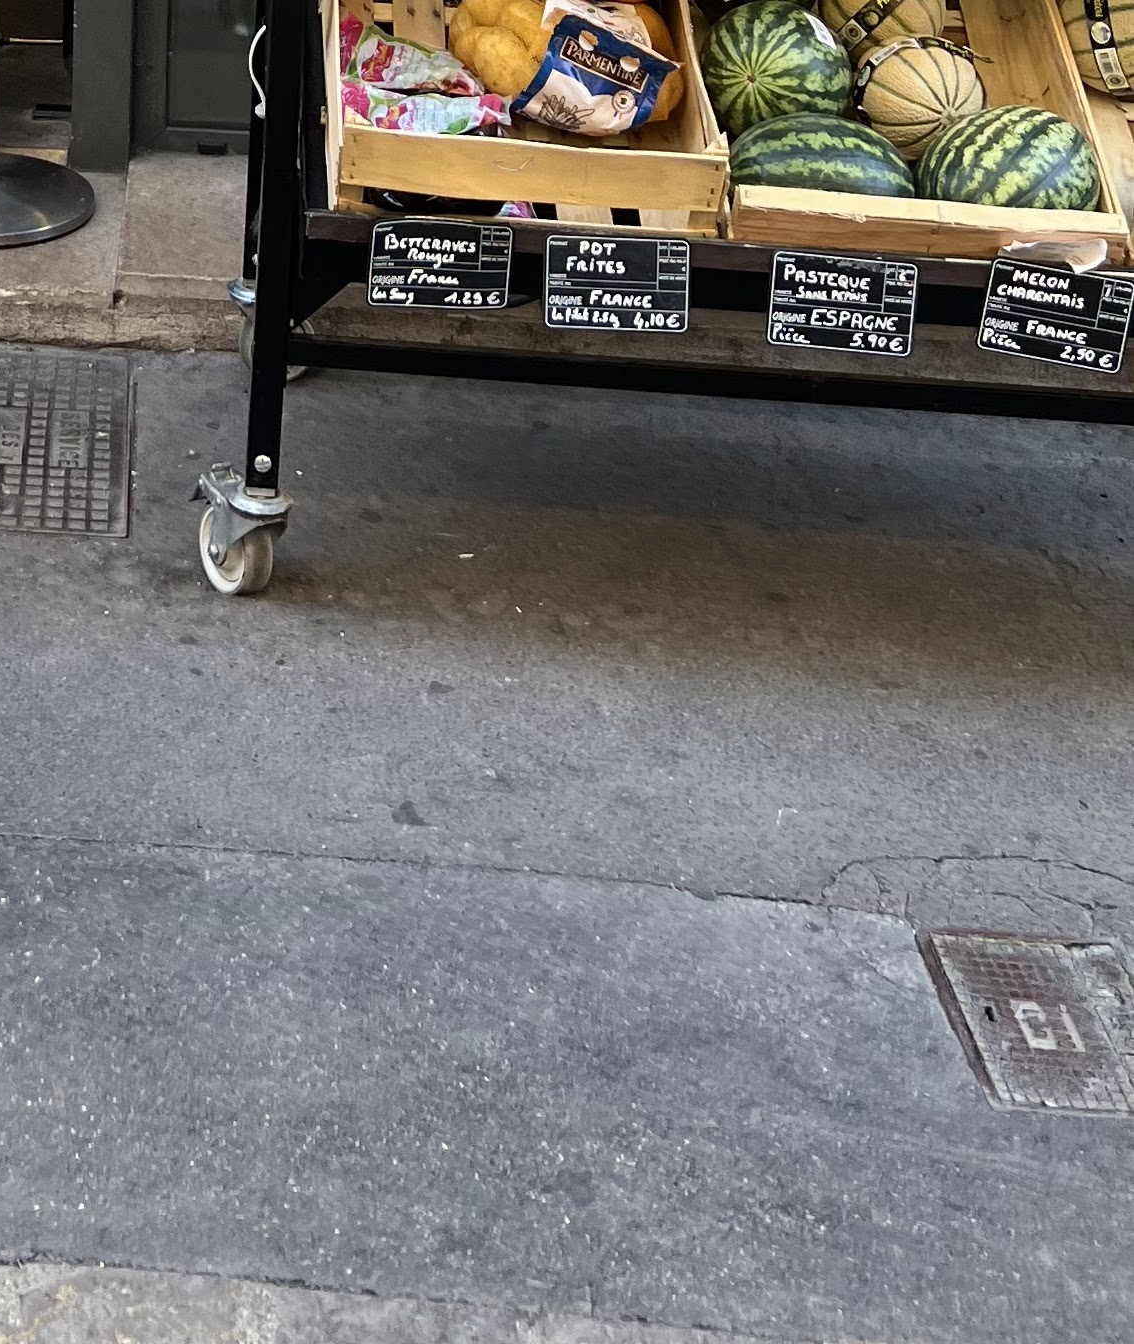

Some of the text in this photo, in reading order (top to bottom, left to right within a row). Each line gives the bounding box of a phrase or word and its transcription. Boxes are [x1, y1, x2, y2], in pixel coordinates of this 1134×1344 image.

[566, 40, 643, 85] PARMENTINE
[384, 233, 476, 254] BETTERAVES
[579, 240, 617, 256] PDT
[407, 249, 455, 270] Rouges
[566, 256, 626, 274] FRITES
[784, 264, 871, 290] PASTEQUE
[1012, 269, 1070, 290] MELON
[548, 289, 653, 309] ORIGINE FRANCE
[795, 286, 828, 300] SANS
[996, 284, 1085, 310] CHARENTAIS
[772, 309, 899, 331] ORIGINE ESPAGNE
[984, 316, 1088, 345] ORIGINE FRANCE
